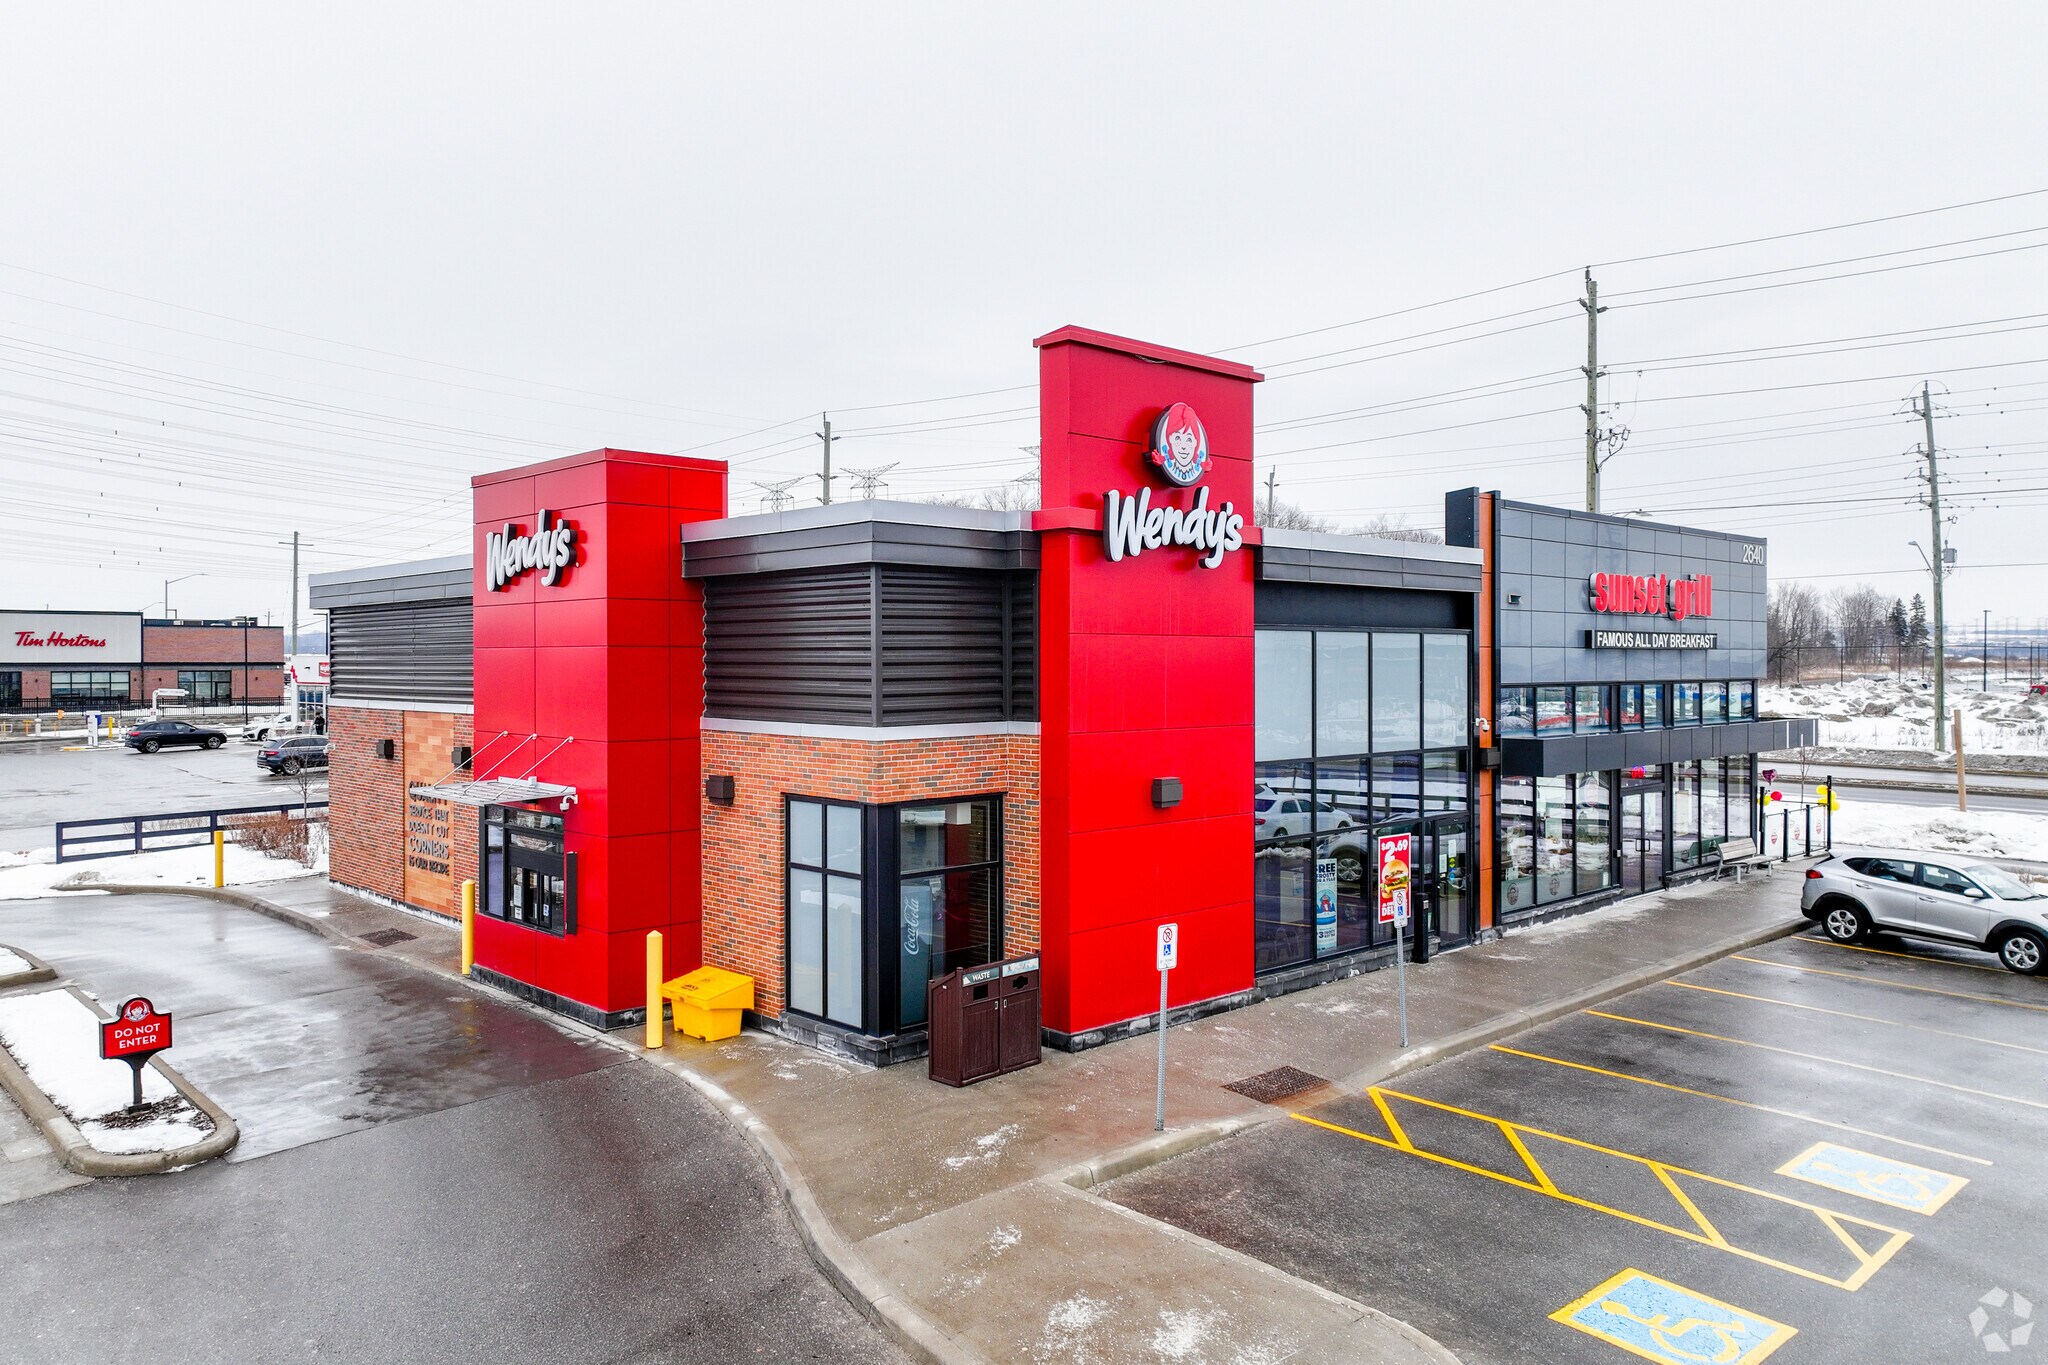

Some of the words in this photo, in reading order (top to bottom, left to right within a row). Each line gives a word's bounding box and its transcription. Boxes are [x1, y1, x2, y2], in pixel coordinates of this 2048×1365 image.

[1103, 486, 1244, 569] Wendy's
[486, 509, 578, 592] Wendy's
[1743, 544, 1764, 564] 2640
[1671, 574, 1712, 621] grill
[15, 631, 44, 647] Tim
[47, 631, 106, 647] Hortons
[1597, 632, 1634, 647] FAMOUS
[1635, 633, 1651, 647] ALL
[1652, 633, 1669, 648] DAY
[1670, 634, 1715, 648] BREAKFAST
[436, 825, 450, 838] CUT
[408, 835, 450, 860] CORNERS
[1381, 839, 1408, 863] $2.69
[1316, 863, 1336, 873] REE
[972, 971, 990, 981] WASTE
[114, 1028, 132, 1039] DO
[135, 1023, 161, 1035] NOT
[119, 1035, 157, 1049] ENTER
